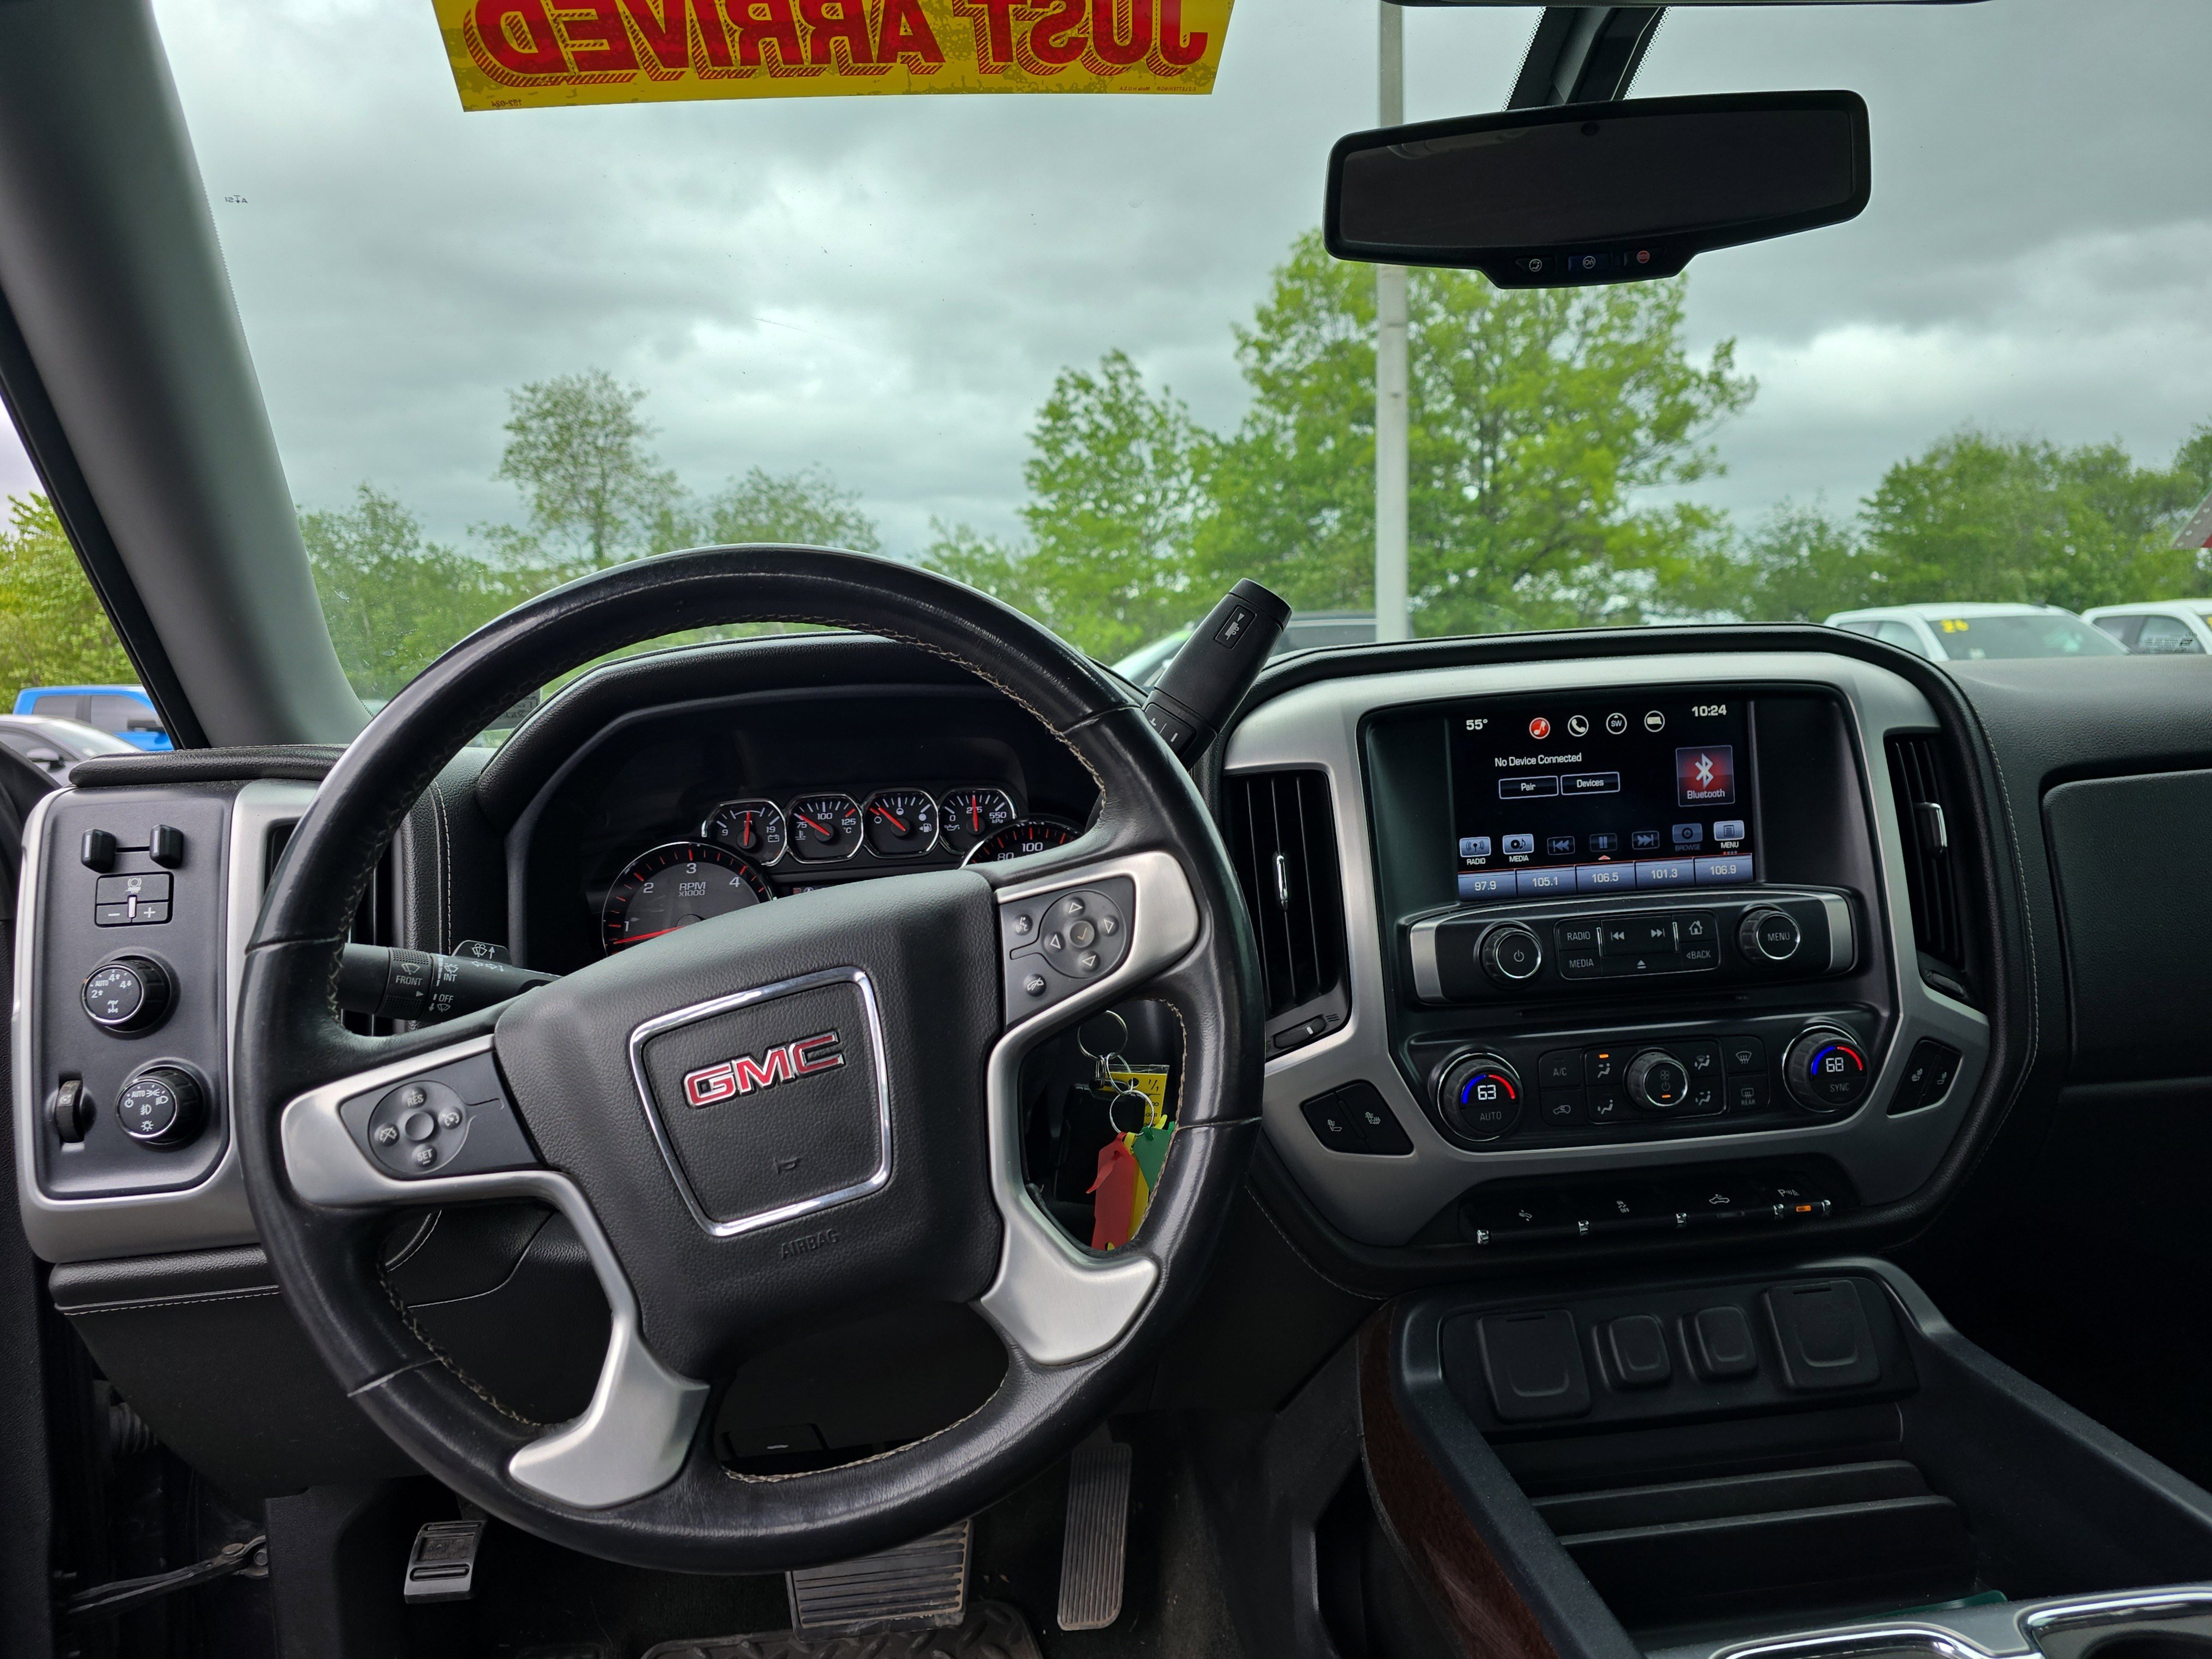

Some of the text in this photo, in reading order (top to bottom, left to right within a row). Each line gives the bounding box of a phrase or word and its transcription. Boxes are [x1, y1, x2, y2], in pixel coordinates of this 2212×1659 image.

[1692, 705, 1727, 717] 10:24
[1466, 719, 1488, 730] 55°
[1495, 753, 1581, 767] No Device Connected
[1521, 782, 1536, 791] Pair
[1577, 779, 1604, 788] Devices
[1687, 789, 1725, 799] Bluetooth
[1021, 842, 1043, 852] 100
[1675, 844, 1701, 852] BROWSE
[998, 852, 1014, 860] 80
[686, 863, 697, 873] 3
[1710, 865, 1737, 875] 106.9
[1592, 873, 1619, 883] 106.5
[1651, 869, 1678, 879] 101.3
[679, 882, 706, 891] RPM
[729, 877, 740, 888] 4
[1475, 881, 1496, 891] 97.9
[1533, 877, 1558, 887] 105.1
[643, 882, 654, 893] 2
[624, 921, 629, 931] 1
[1567, 931, 1591, 941] RADIO
[1767, 931, 1790, 942] MENU
[1690, 949, 1712, 960] BACK
[1569, 957, 1594, 968] MEDIA
[396, 975, 423, 986] FRONT
[443, 974, 457, 982] INT
[439, 994, 454, 1004] OFF
[682, 1030, 845, 1107] GMC
[1825, 1058, 1844, 1072] 68
[1553, 1066, 1567, 1077] A/C
[1477, 1085, 1497, 1100] 63
[1830, 1083, 1850, 1092] SYNC
[132, 1090, 145, 1098] AUTO
[407, 1095, 424, 1107] RES
[1740, 1098, 1756, 1106] REAR
[1480, 1110, 1502, 1121] AUTO
[417, 1149, 433, 1161] SET
[782, 1229, 839, 1258] AIRBAG
